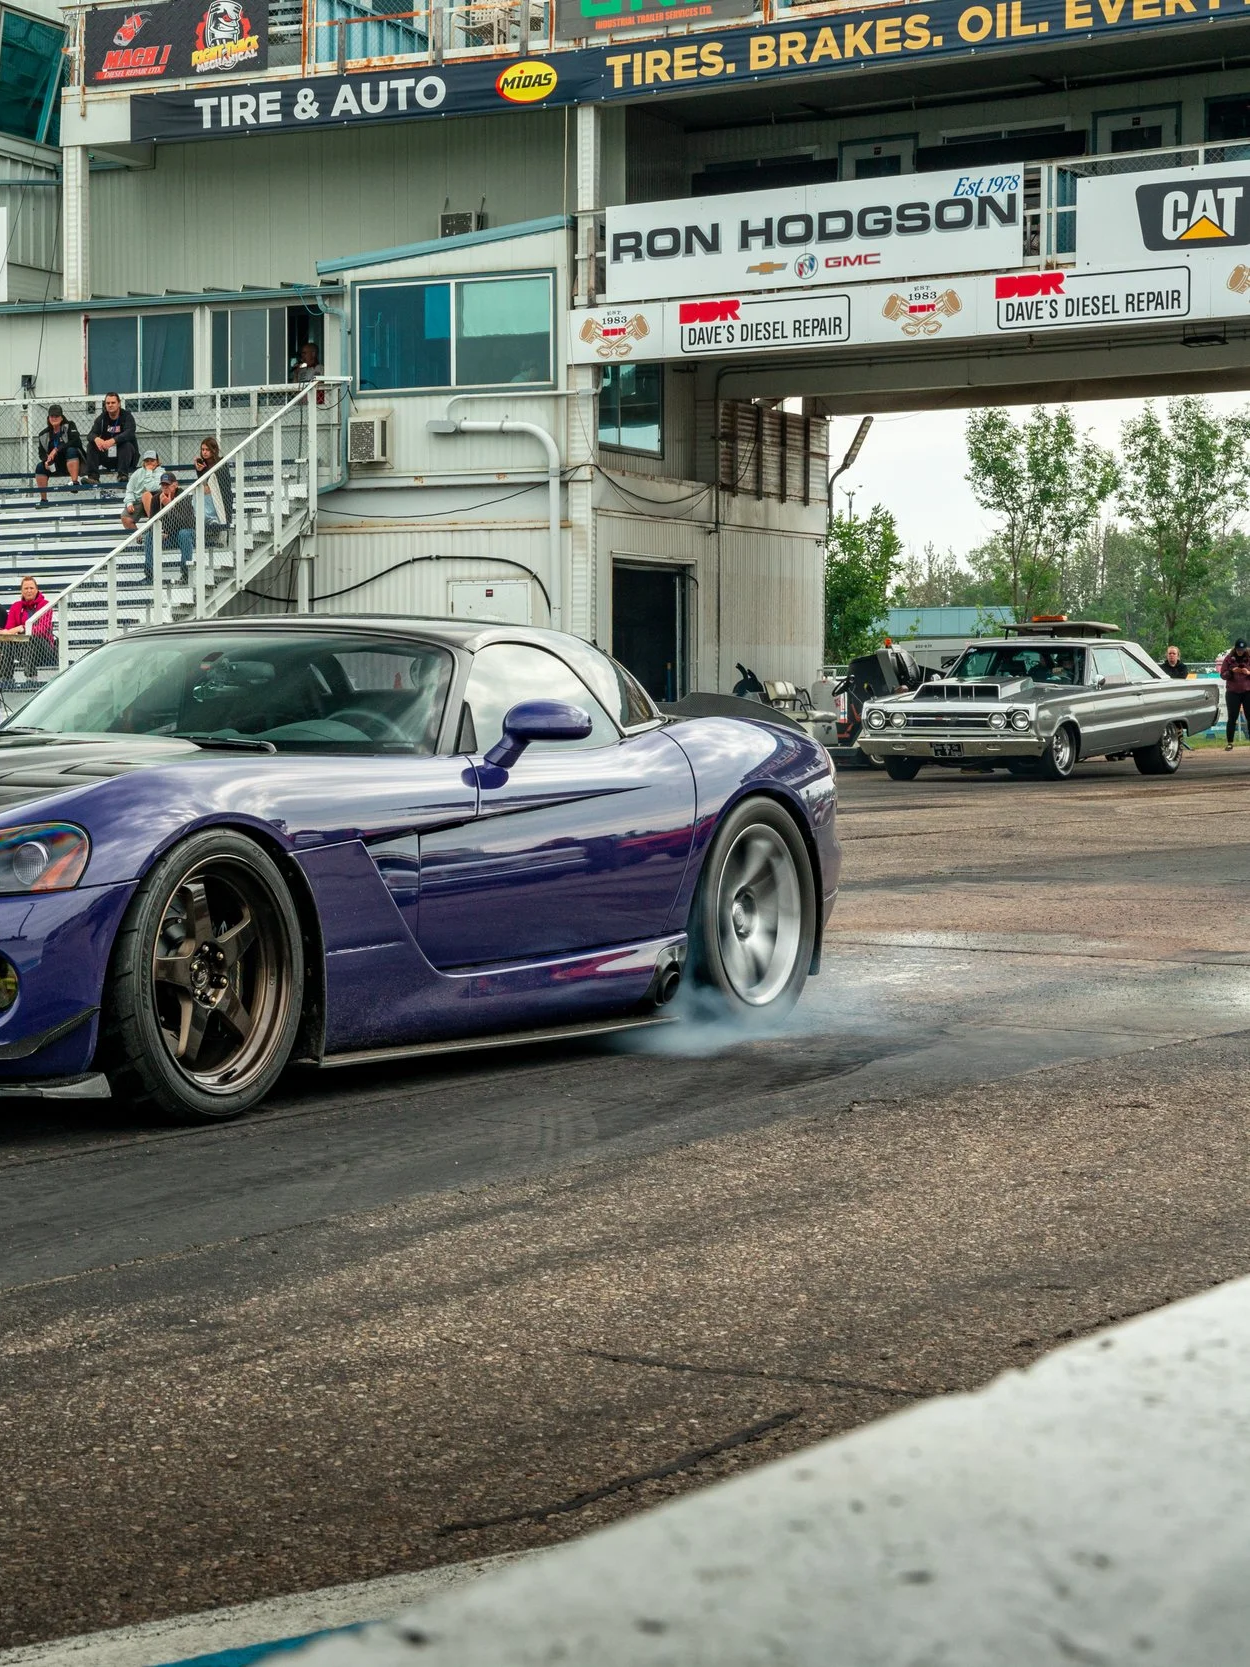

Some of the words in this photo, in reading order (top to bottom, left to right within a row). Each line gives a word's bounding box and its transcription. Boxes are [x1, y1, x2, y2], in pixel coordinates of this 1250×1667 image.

[595, 15, 636, 30] INDUSTRIAL
[637, 11, 664, 24] TRAILER
[665, 7, 699, 22] SERVICES
[102, 46, 159, 70] MACH
[194, 90, 283, 129] TIRE
[293, 87, 320, 120] &
[331, 75, 447, 118] AUTO
[606, 42, 736, 89] TIRES.
[750, 14, 943, 71] BRAKES.
[958, 1, 1049, 42] OIL.
[1162, 186, 1244, 241] CAT
[610, 222, 722, 264] RON
[738, 193, 1020, 251] HODGSON
[825, 252, 881, 269] GMC
[908, 291, 937, 301] 1983
[995, 272, 1066, 300] DDR
[679, 299, 741, 325] DDR
[908, 303, 936, 314] DDR
[1005, 299, 1059, 323] DAVE'S
[1065, 294, 1120, 319] DIESEL
[1125, 289, 1182, 314] REPAIR
[602, 316, 627, 325] 1983
[602, 327, 627, 337] DDR
[688, 323, 735, 347] DAVE'S
[740, 319, 789, 342] DIESEL
[793, 316, 843, 339] REPAIR
